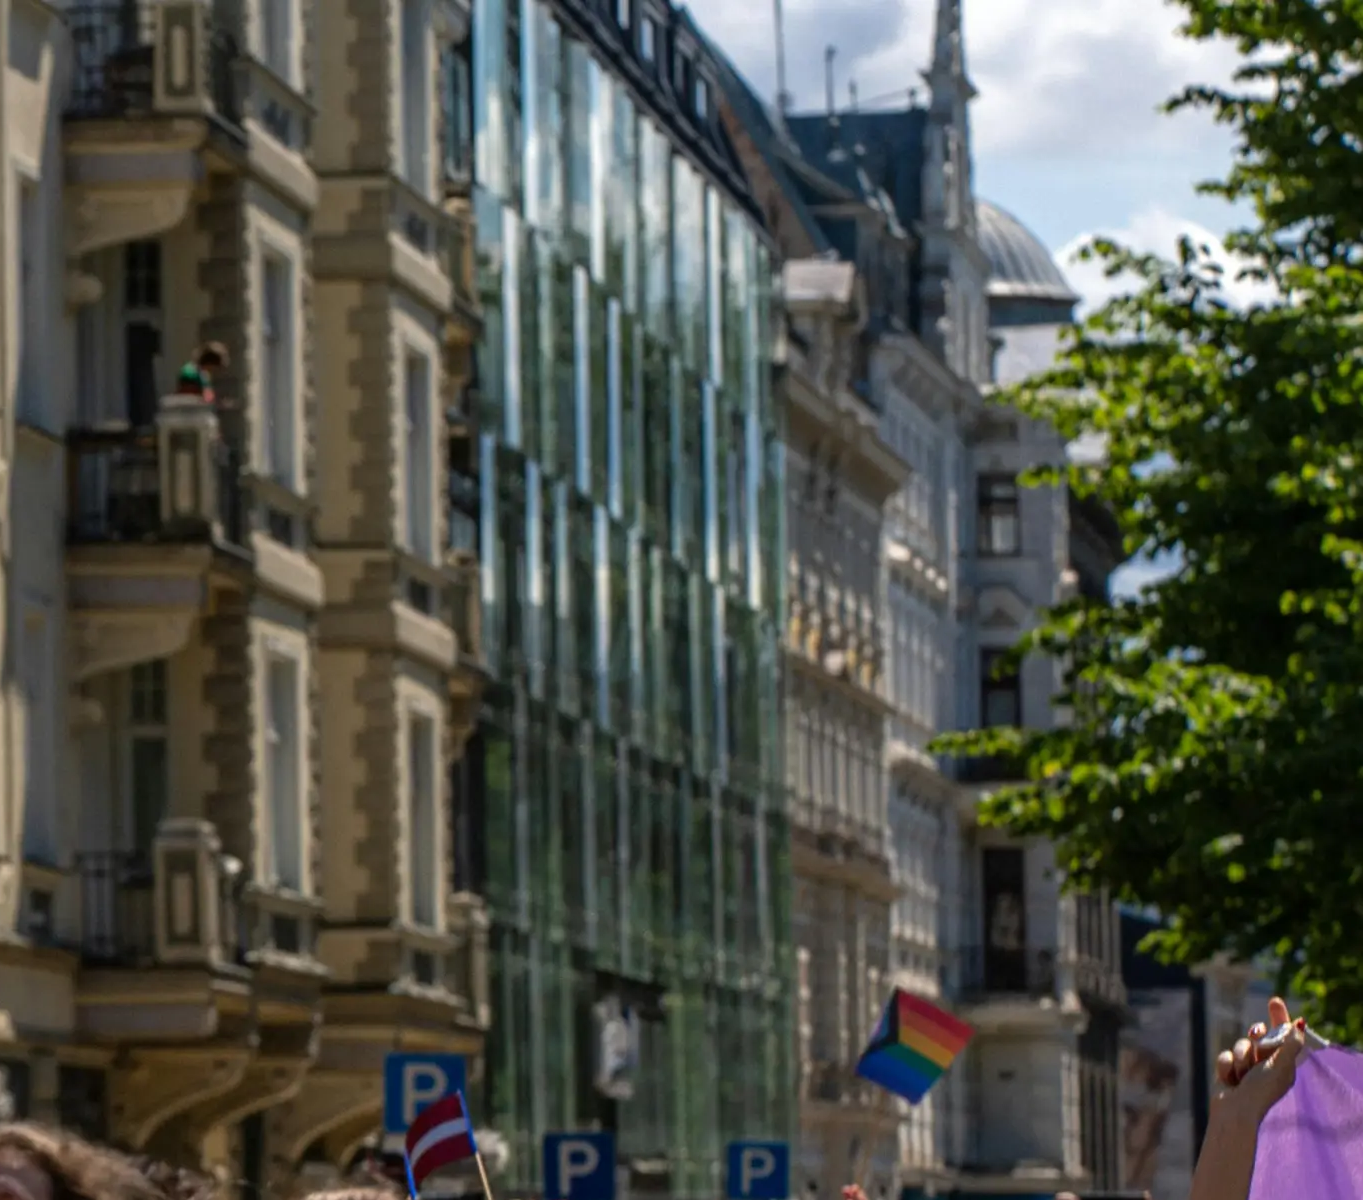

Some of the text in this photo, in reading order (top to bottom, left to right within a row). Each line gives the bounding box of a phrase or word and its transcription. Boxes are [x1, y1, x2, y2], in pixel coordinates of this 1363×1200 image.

[401, 1062, 449, 1124] P
[557, 1140, 600, 1195] P
[740, 1149, 775, 1194] P
